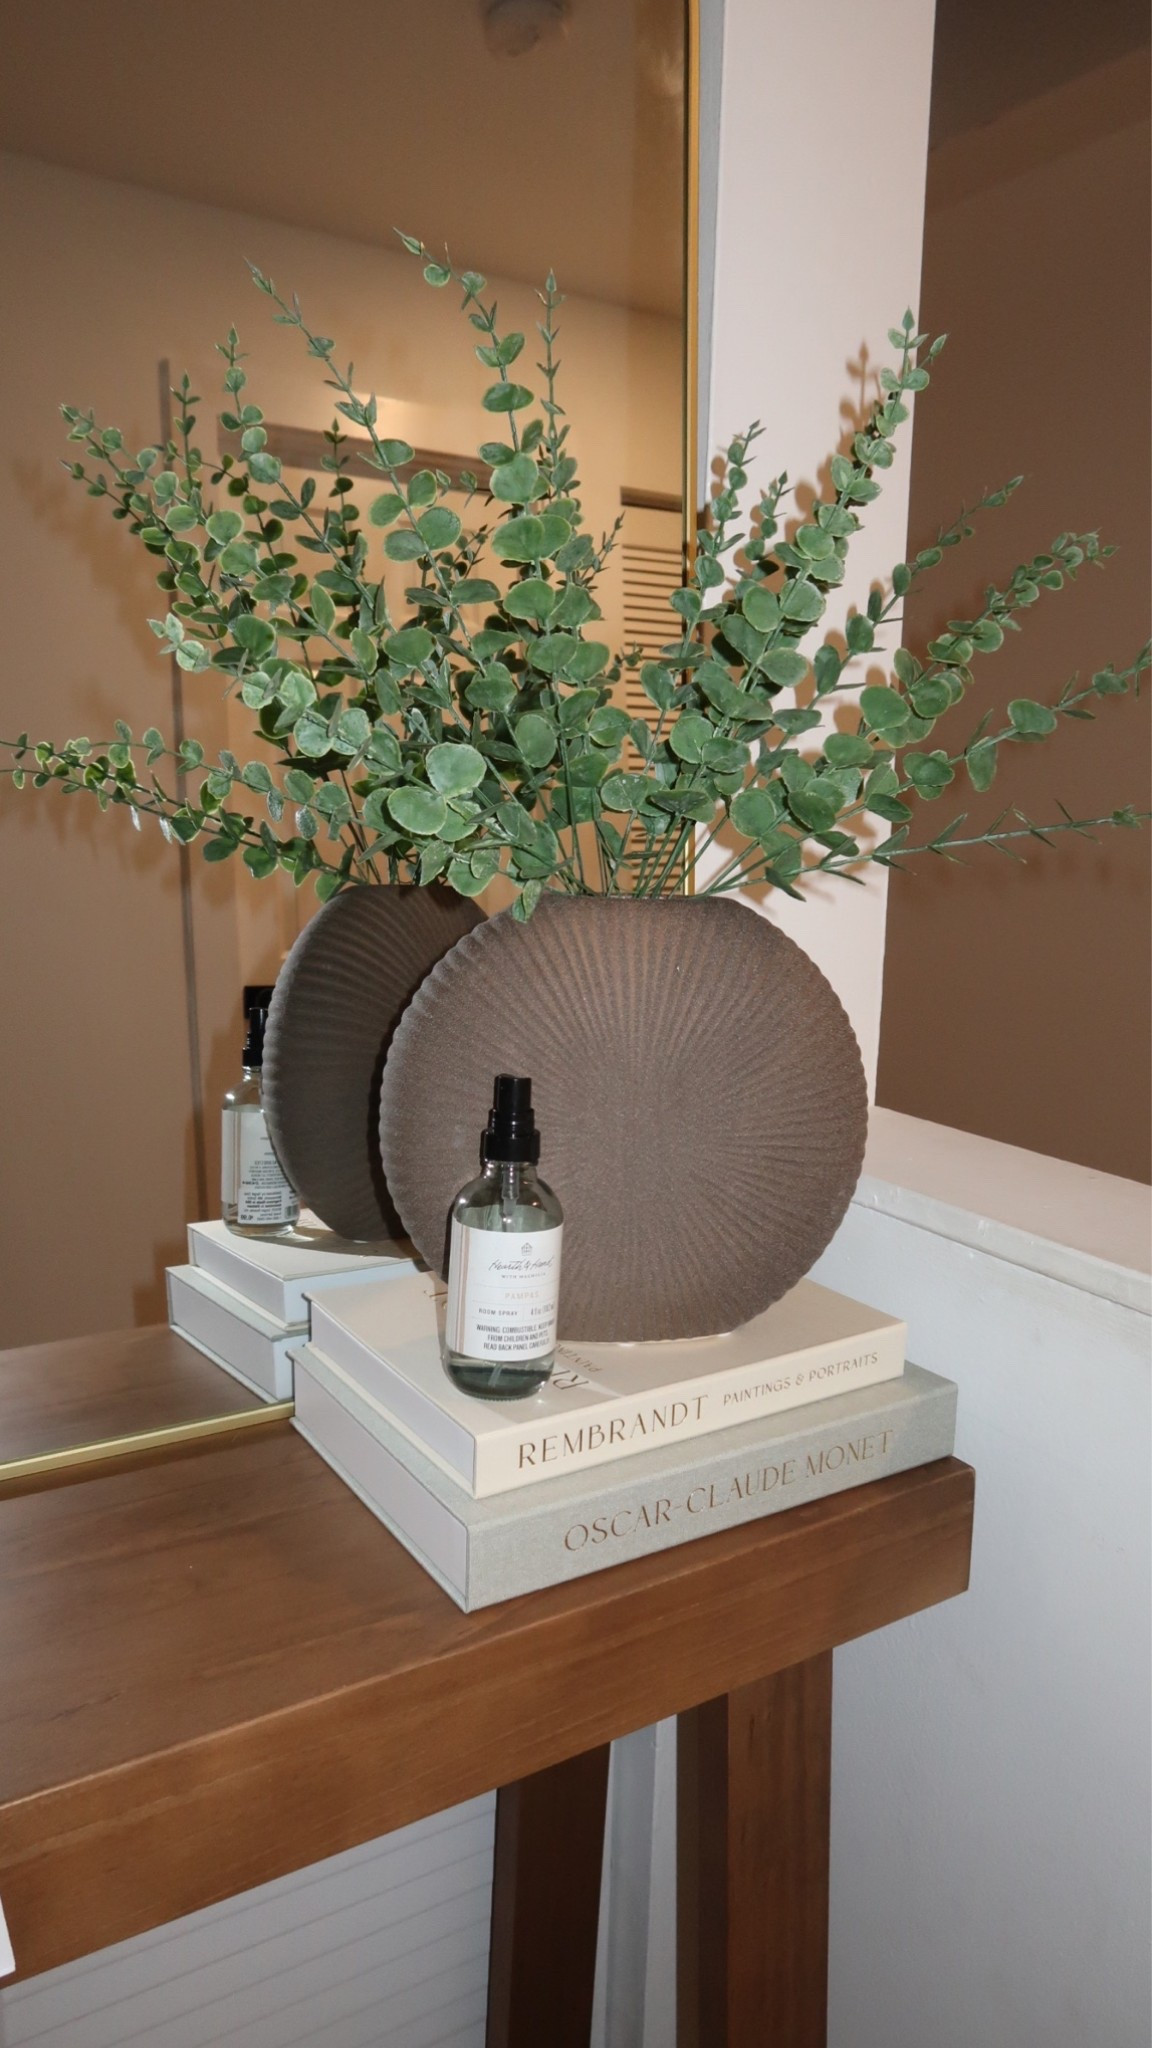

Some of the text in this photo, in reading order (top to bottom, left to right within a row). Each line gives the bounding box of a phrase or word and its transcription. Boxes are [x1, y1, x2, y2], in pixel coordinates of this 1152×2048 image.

[504, 1290, 540, 1300] PAMPAS
[478, 1307, 496, 1316] ROOM
[487, 1334, 503, 1342] FROM
[503, 1335, 529, 1343] CHILDREN
[529, 1332, 539, 1341] AND
[483, 1342, 498, 1351] READ
[498, 1344, 512, 1352] BACK
[512, 1343, 528, 1352] PANEL
[518, 1351, 879, 1469] REMBRANDT PAINTINGS & PORTRAITS
[564, 1429, 894, 1552] OSCAR-CLAUDE MONET
